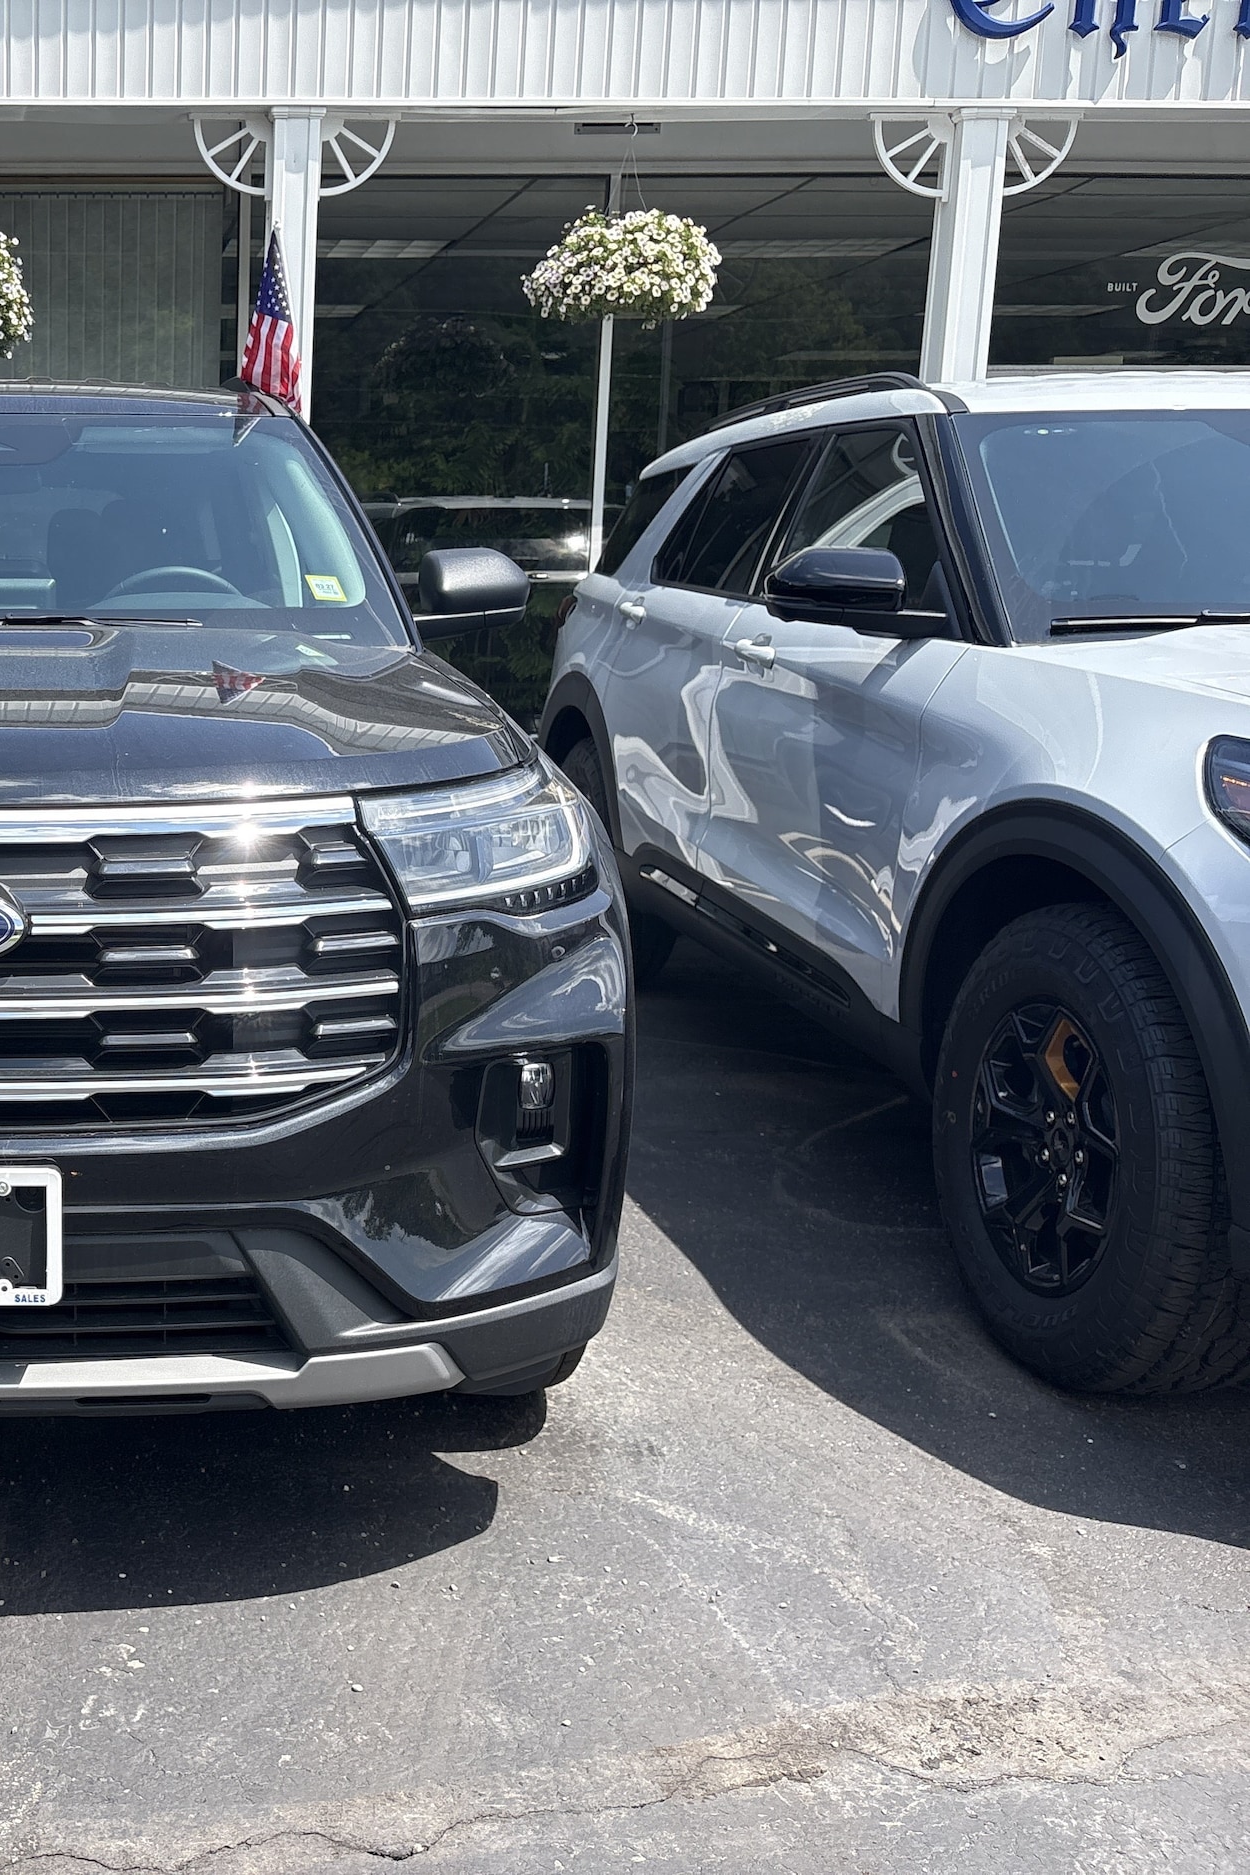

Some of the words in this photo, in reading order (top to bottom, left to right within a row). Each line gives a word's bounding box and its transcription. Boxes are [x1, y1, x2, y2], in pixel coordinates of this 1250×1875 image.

[1106, 282, 1138, 292] BUILT
[1136, 252, 1250, 326] For
[14, 1293, 47, 1304] SALES
